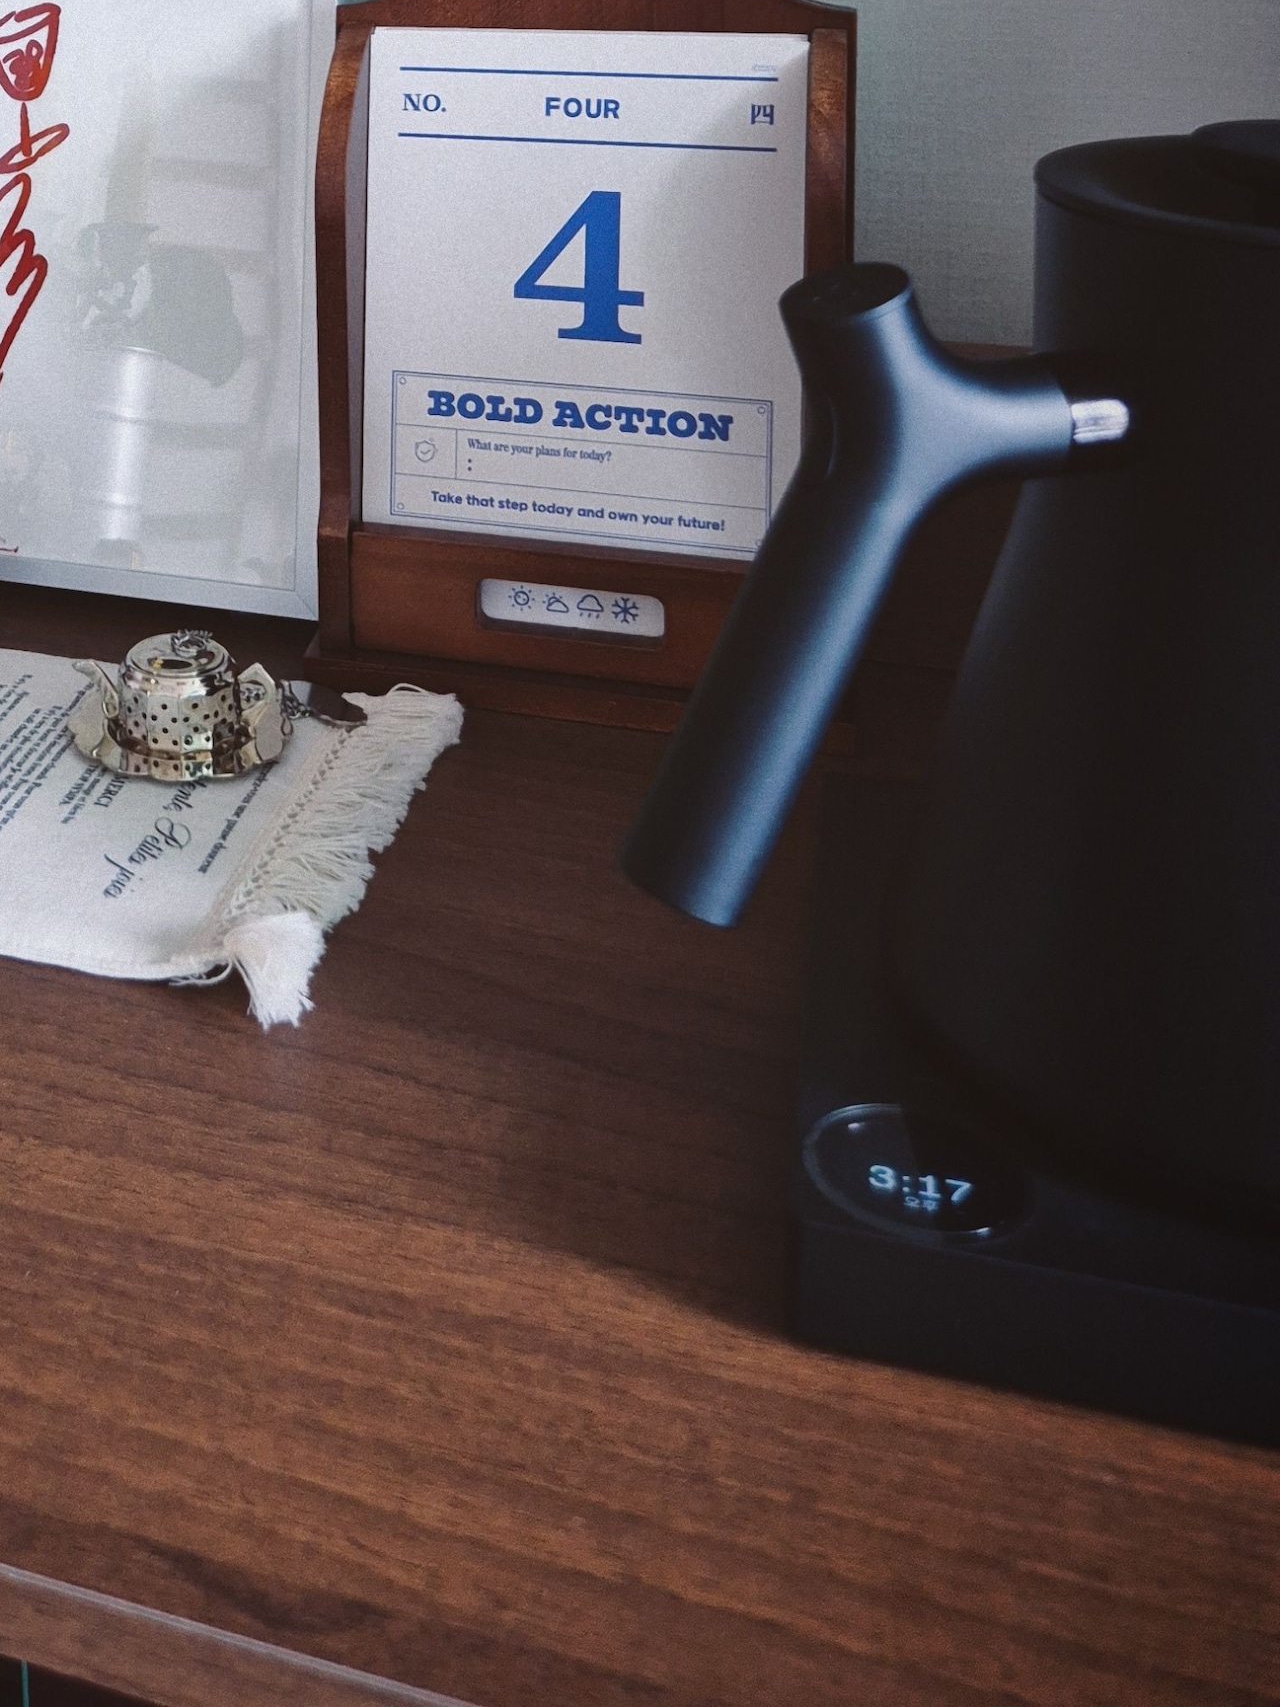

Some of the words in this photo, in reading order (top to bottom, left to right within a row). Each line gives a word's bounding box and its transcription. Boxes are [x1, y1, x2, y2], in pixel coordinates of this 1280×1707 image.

[401, 93, 447, 113] NO.
[544, 97, 620, 120] FOUR
[750, 103, 775, 126] 四
[513, 190, 645, 345] 4
[426, 389, 543, 425] BOLD
[552, 400, 734, 442] ACTION
[467, 438, 491, 451] What
[493, 443, 509, 452] are
[510, 444, 533, 455] your
[535, 445, 561, 457] plans
[563, 447, 577, 458] for
[579, 450, 612, 463] today?
[431, 490, 463, 505] Take
[466, 494, 495, 508] that
[498, 498, 528, 512] step
[532, 501, 573, 516] today
[577, 507, 604, 519] and
[608, 511, 637, 522] own
[642, 513, 674, 526] your
[678, 515, 725, 531] future!
[868, 1164, 972, 1202] 3:17
